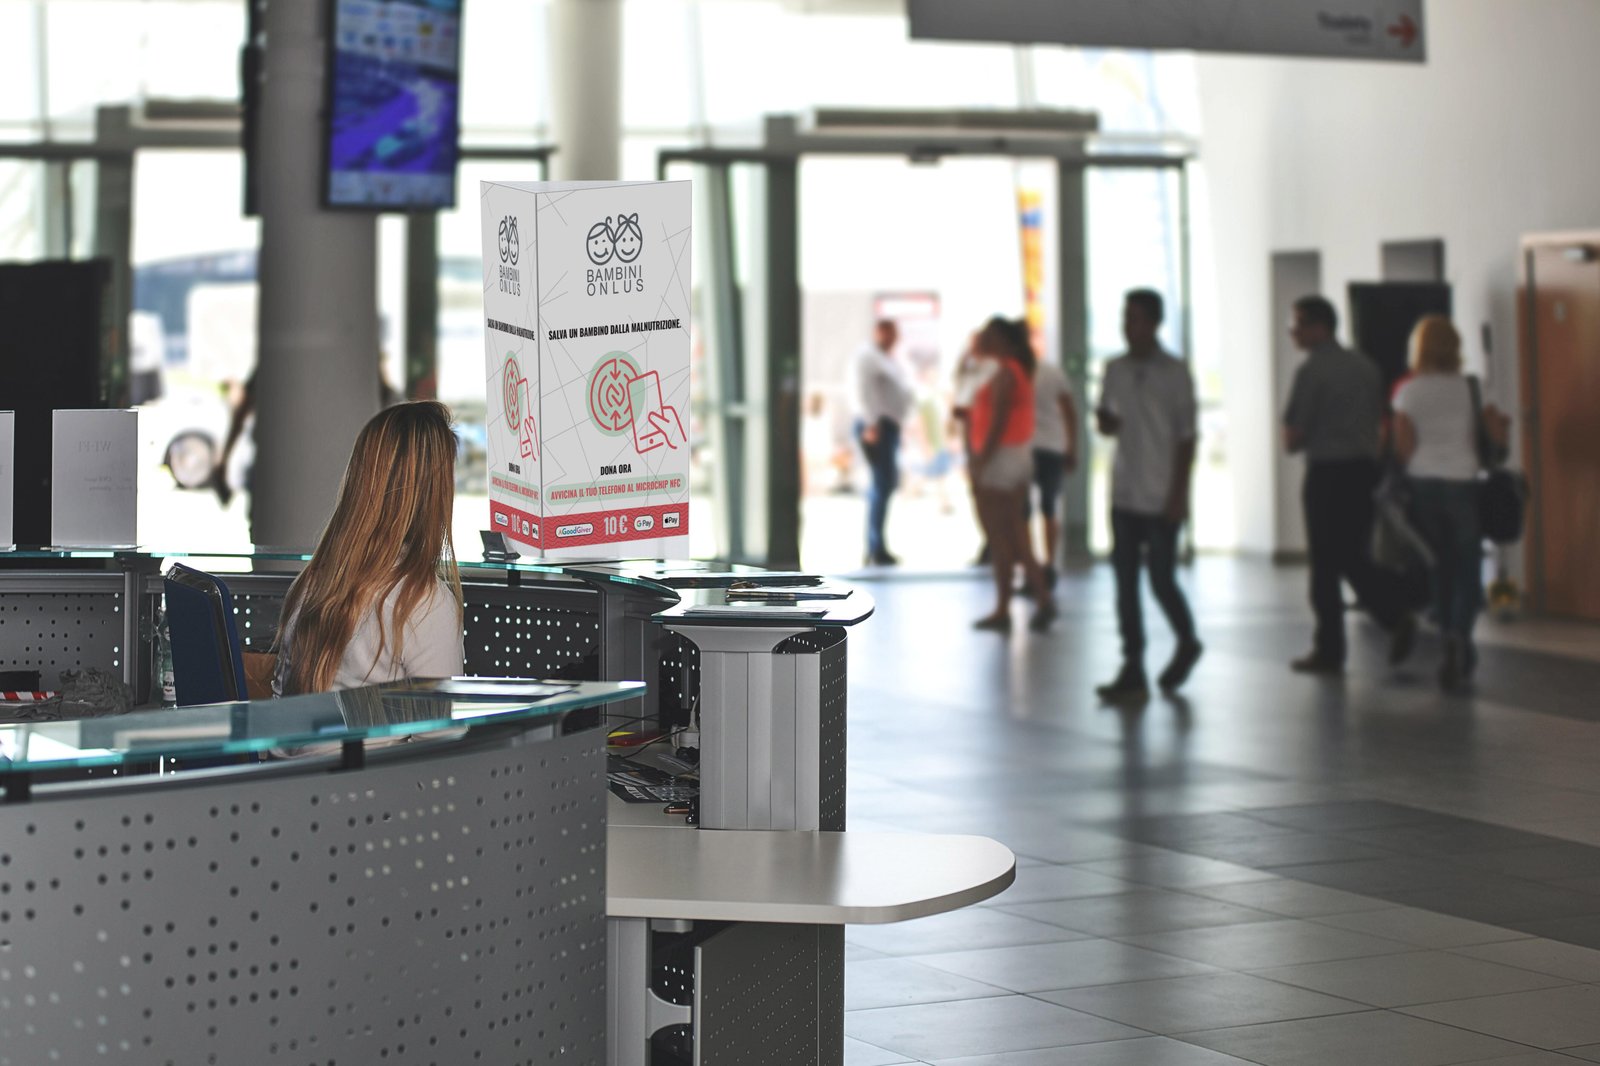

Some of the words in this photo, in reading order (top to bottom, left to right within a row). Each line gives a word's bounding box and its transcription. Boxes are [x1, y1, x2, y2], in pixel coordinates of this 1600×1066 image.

[586, 265, 642, 282] BAMBINI
[586, 279, 644, 296] ONLUS
[548, 330, 568, 341] SALVA
[569, 329, 578, 339] UN
[579, 326, 609, 337] BAMBINO
[610, 324, 630, 335] DALLA
[631, 319, 682, 332] MALNUTRIZIONE.
[600, 466, 617, 476] DONA
[618, 464, 632, 474] ORA
[551, 490, 577, 501] AVVICINA
[578, 489, 585, 498] IL
[585, 487, 598, 497] TUO
[599, 484, 626, 495] TELEFONO
[627, 484, 634, 493] AL
[635, 480, 669, 492] MICROCHIP
[669, 478, 681, 488] NFC
[604, 516, 617, 535] 10
[619, 515, 628, 534] €
[636, 519, 642, 528] G
[642, 518, 652, 528] Pay
[668, 517, 678, 525] Pay
